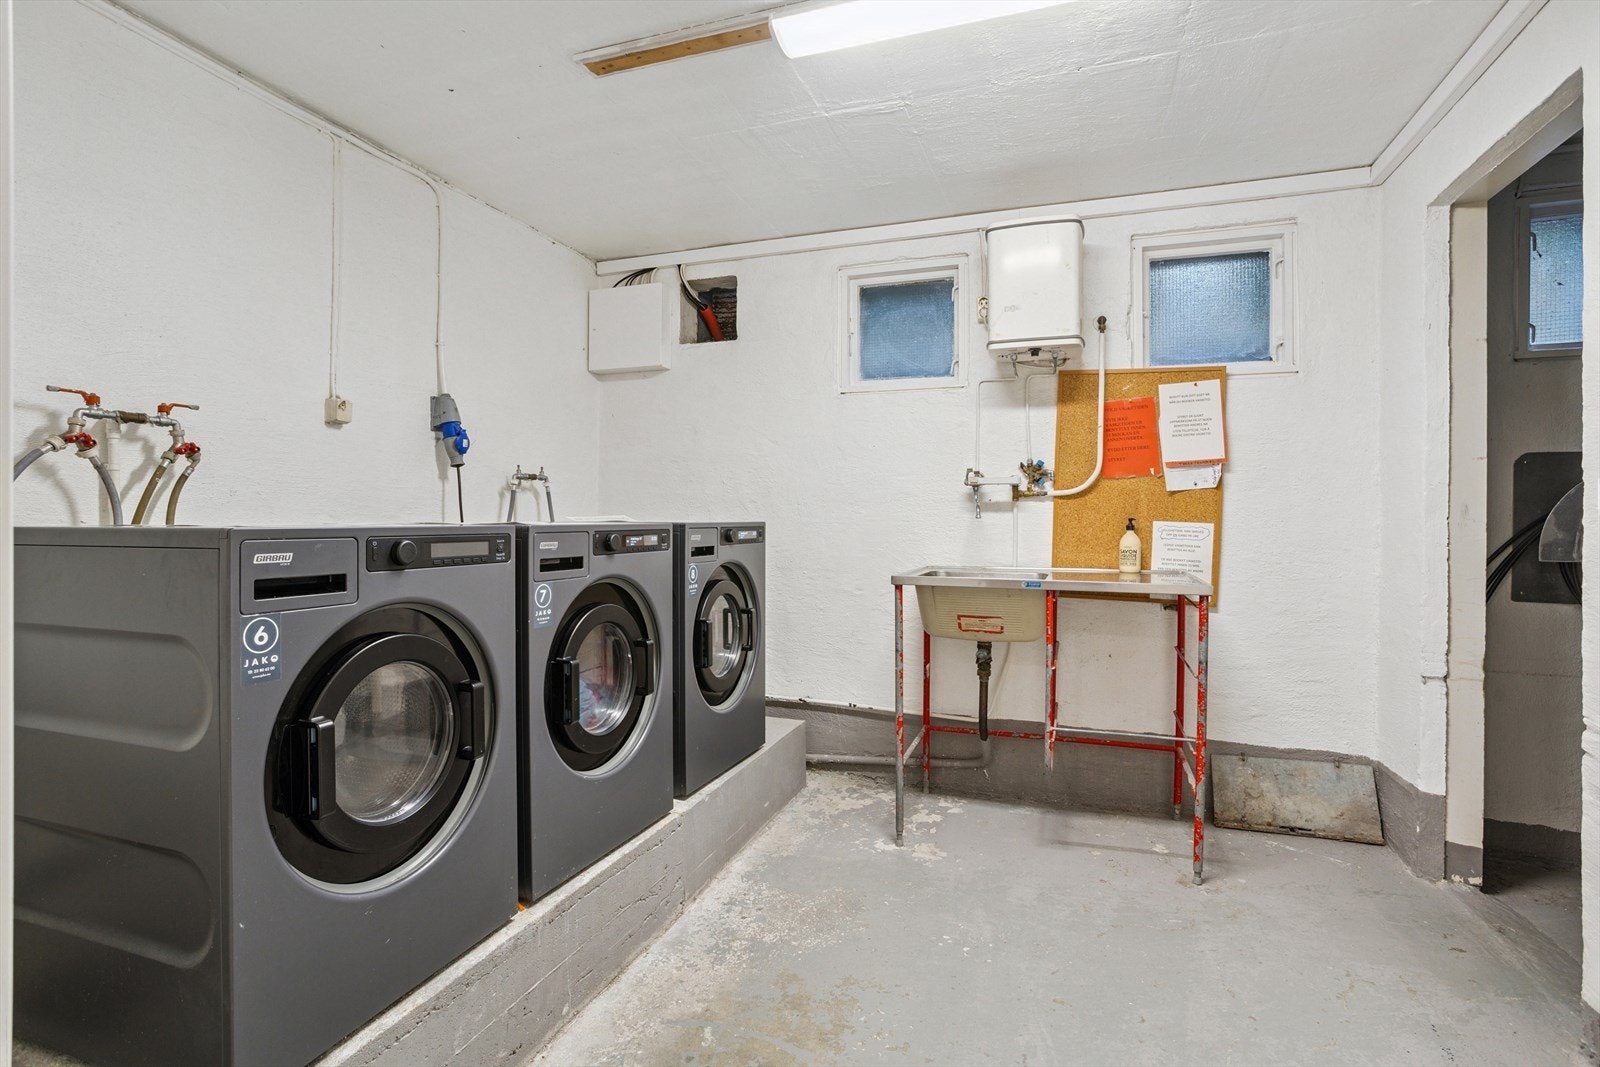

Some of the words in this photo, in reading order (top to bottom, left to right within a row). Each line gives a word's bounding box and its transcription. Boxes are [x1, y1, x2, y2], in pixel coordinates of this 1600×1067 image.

[691, 569, 695, 579] 8
[540, 590, 547, 603] 7
[254, 625, 268, 645] 6
[244, 654, 278, 668] JAKO
